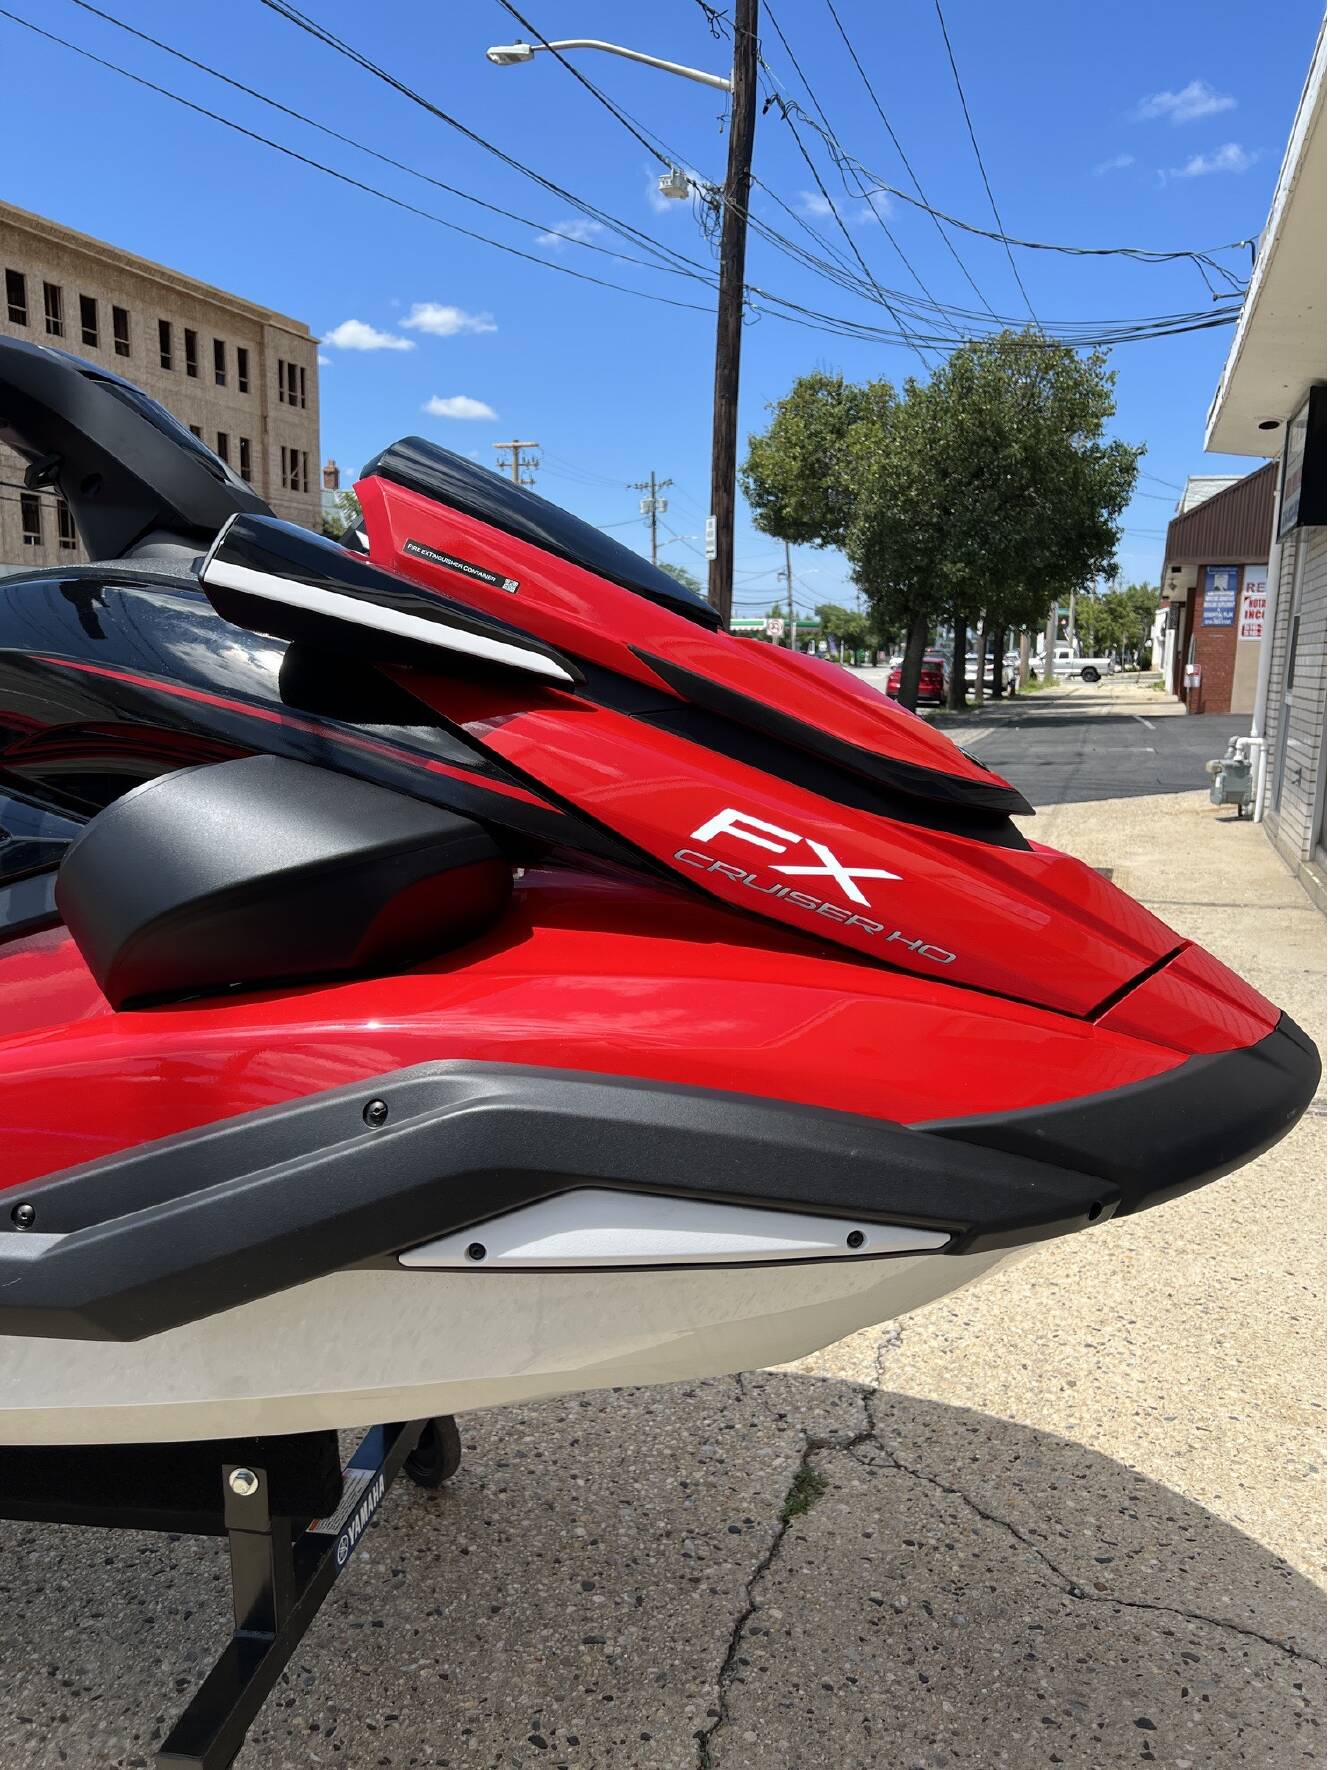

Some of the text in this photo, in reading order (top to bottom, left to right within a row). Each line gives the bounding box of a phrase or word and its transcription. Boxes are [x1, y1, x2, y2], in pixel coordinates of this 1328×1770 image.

[407, 543, 497, 582] FIRE EXTINGUISHER CONTAINER
[690, 808, 903, 908] FX
[673, 849, 957, 964] CRUISER HO
[348, 1473, 385, 1546] YAMAHA
